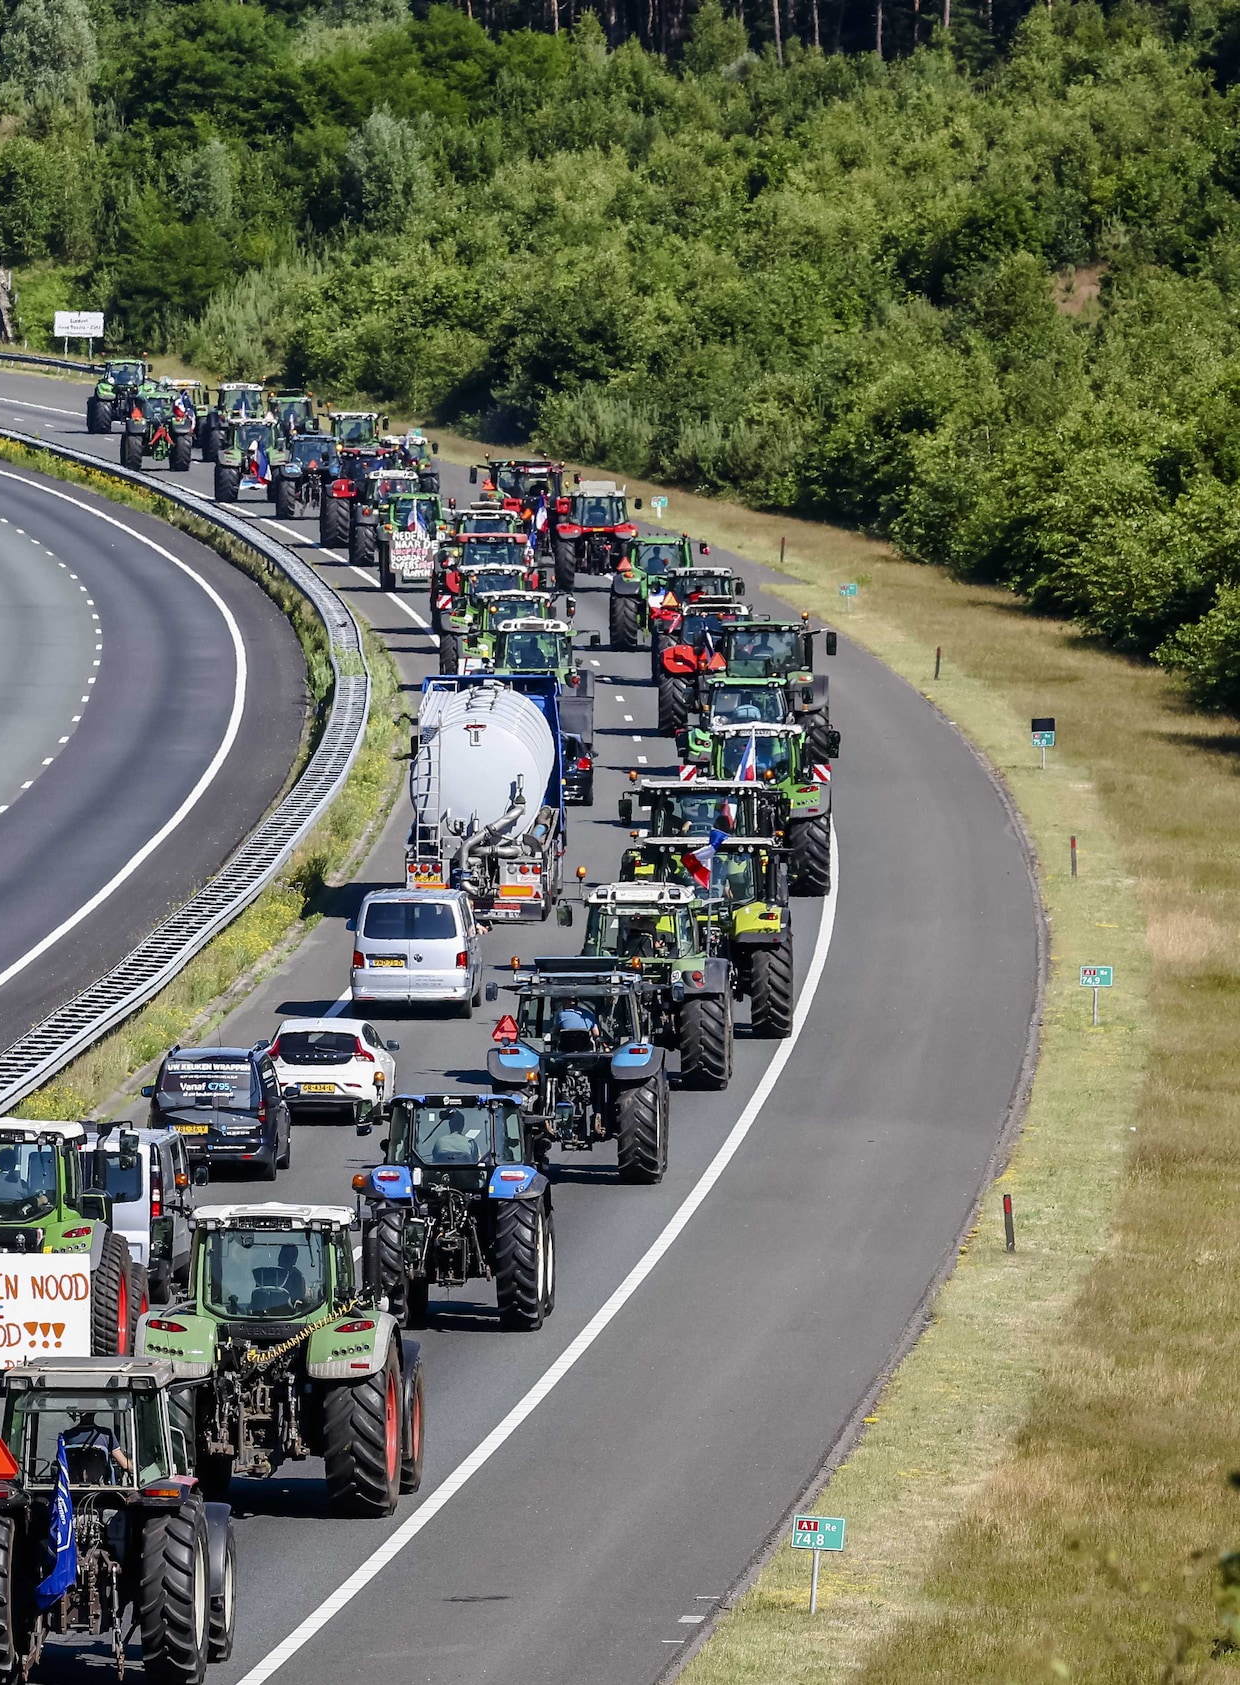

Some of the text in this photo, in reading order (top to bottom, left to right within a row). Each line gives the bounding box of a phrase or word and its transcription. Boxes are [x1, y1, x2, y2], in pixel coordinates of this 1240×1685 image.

[392, 530, 445, 541] NEDERLD
[395, 540, 439, 549] NAAR DE
[1082, 976, 1101, 985] 74,9
[181, 1063, 213, 1071] KEUKEN
[213, 1063, 251, 1071] WRAPPEN
[180, 1082, 206, 1091] Vanaf
[31, 1273, 89, 1301] NOOD
[801, 1521, 837, 1532] A1 Re
[795, 1532, 825, 1547] 74,8
